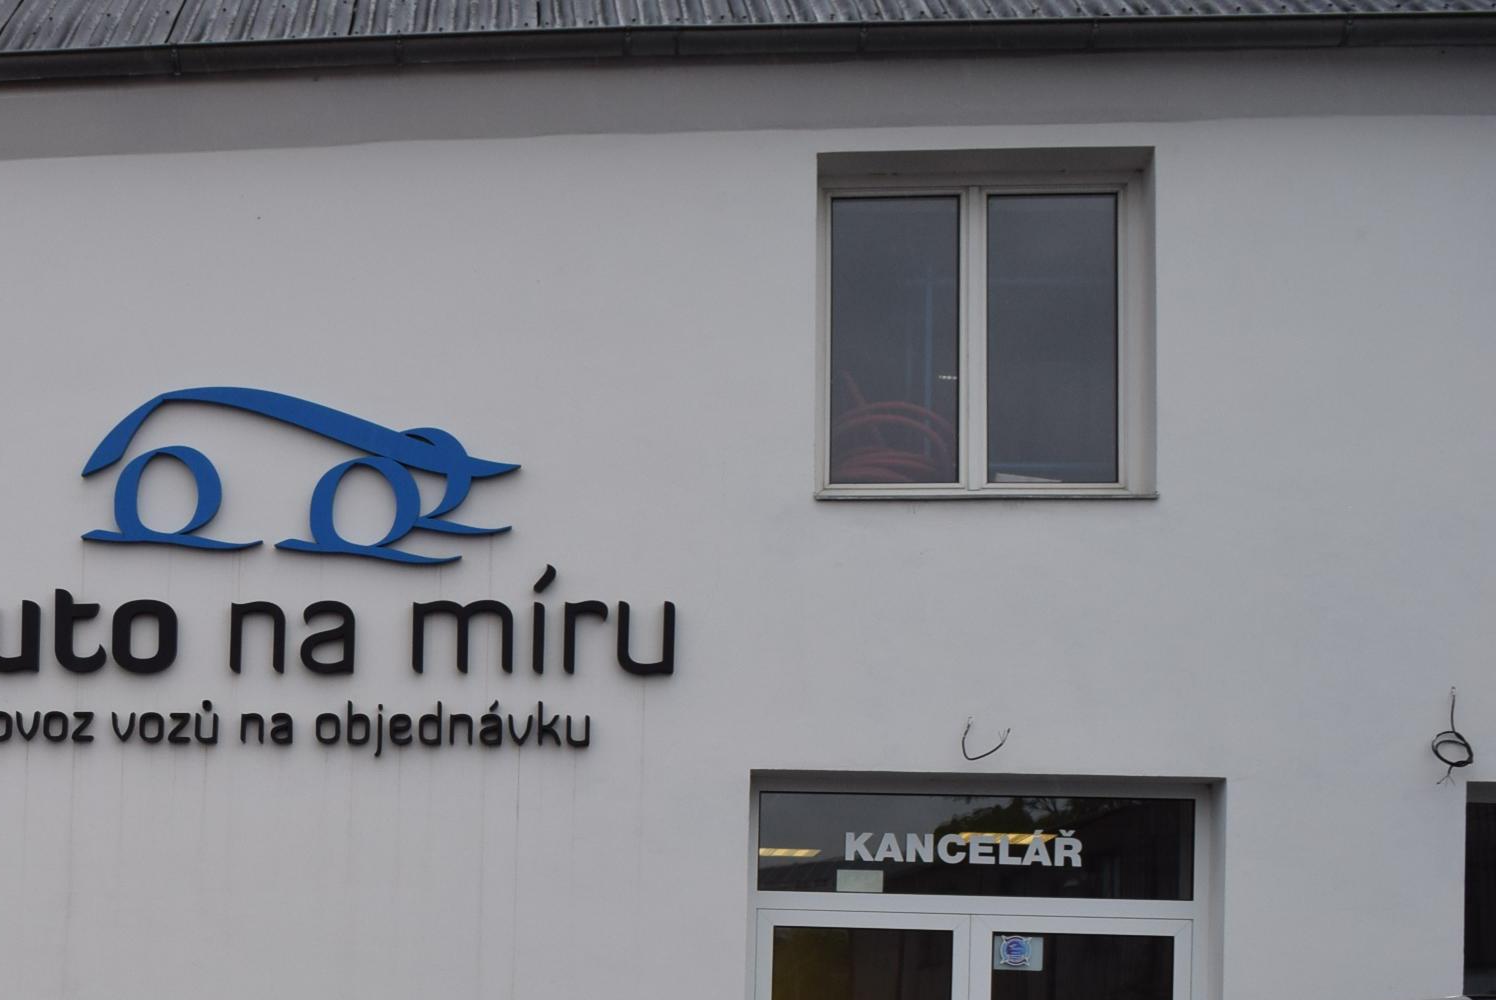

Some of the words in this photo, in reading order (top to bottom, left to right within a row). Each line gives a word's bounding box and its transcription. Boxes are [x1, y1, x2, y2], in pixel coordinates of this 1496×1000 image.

[229, 600, 356, 679] na
[412, 564, 676, 681] míru
[111, 699, 220, 748] vozů
[239, 712, 294, 749] na
[315, 699, 591, 759] objednávku
[844, 829, 1083, 868] KANCELÁŘ
